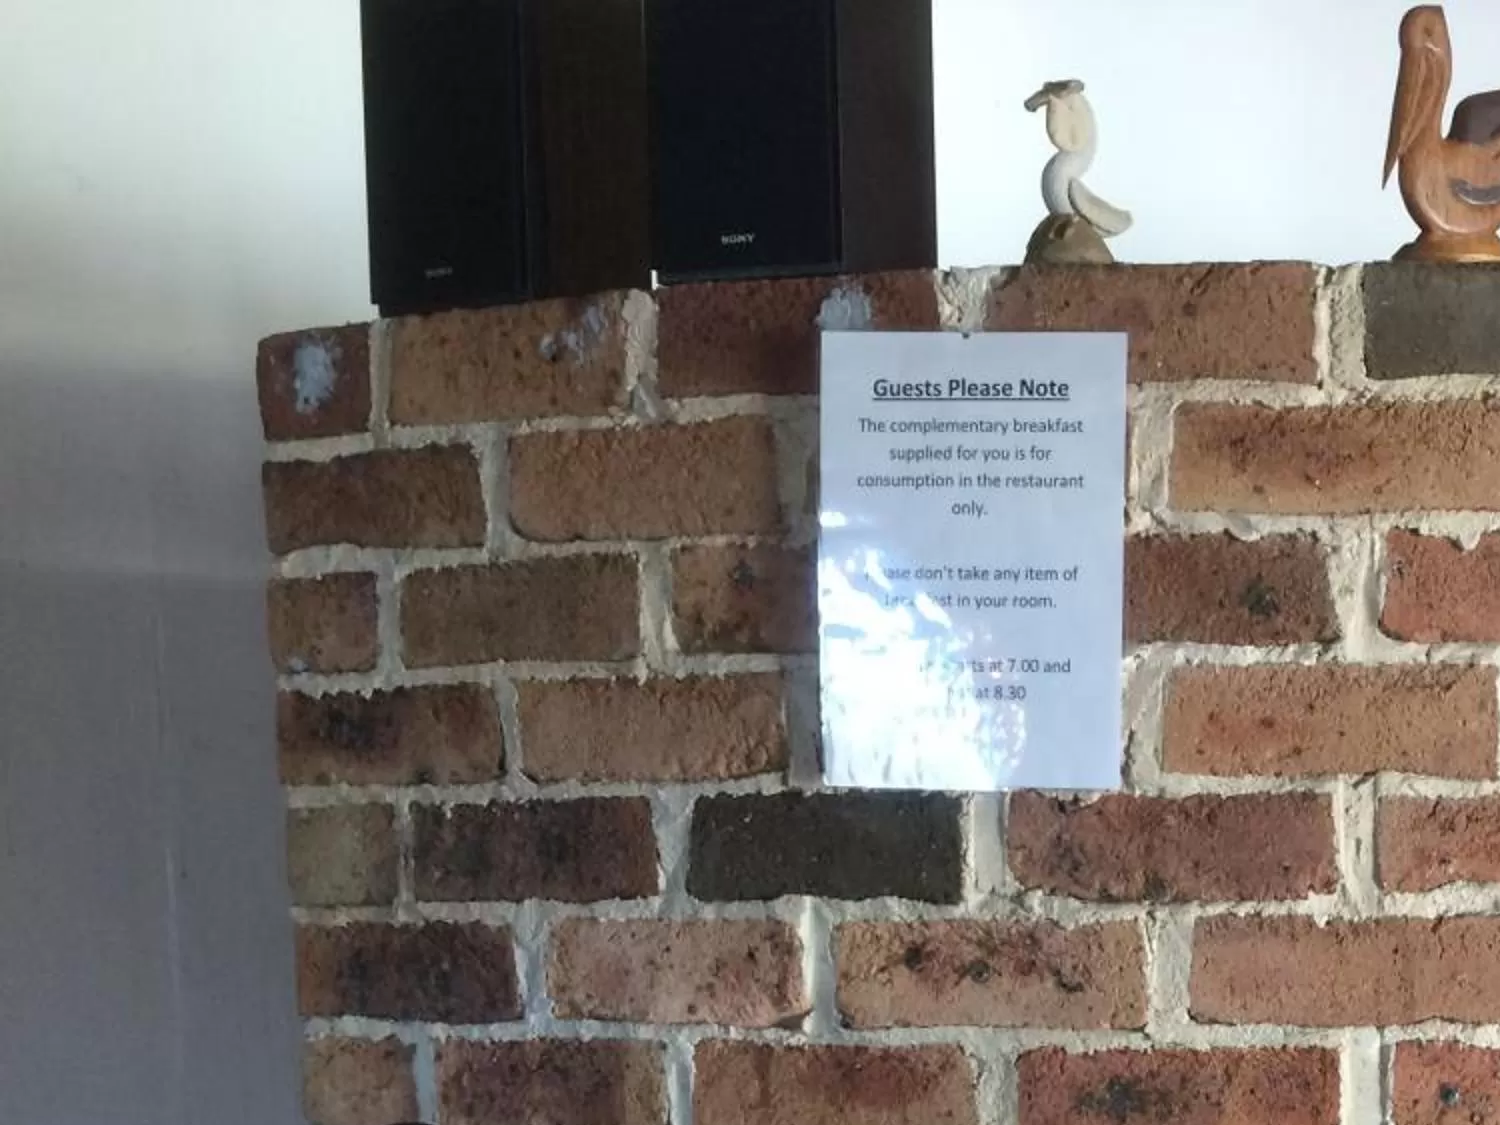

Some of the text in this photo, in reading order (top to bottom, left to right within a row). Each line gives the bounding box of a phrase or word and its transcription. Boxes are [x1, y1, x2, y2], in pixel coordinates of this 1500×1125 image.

[872, 378, 1070, 399] Guests Please Note
[858, 417, 1084, 436] The complementary breakfast
[889, 444, 1053, 462] supplied for you is for
[857, 473, 1084, 490] consumption in the restaurant
[951, 500, 988, 518] only.
[914, 564, 953, 581] don't
[957, 565, 988, 581] take
[993, 567, 1020, 583] any
[1024, 565, 1059, 581] item
[1062, 565, 1079, 581] of
[957, 593, 970, 608] in
[974, 596, 1007, 610] your
[1012, 596, 1057, 609] room.
[988, 659, 1003, 673] at
[1008, 658, 1040, 673] 7.00
[1043, 658, 1071, 673] and
[975, 686, 991, 699] at
[993, 685, 1027, 700] 8.30
